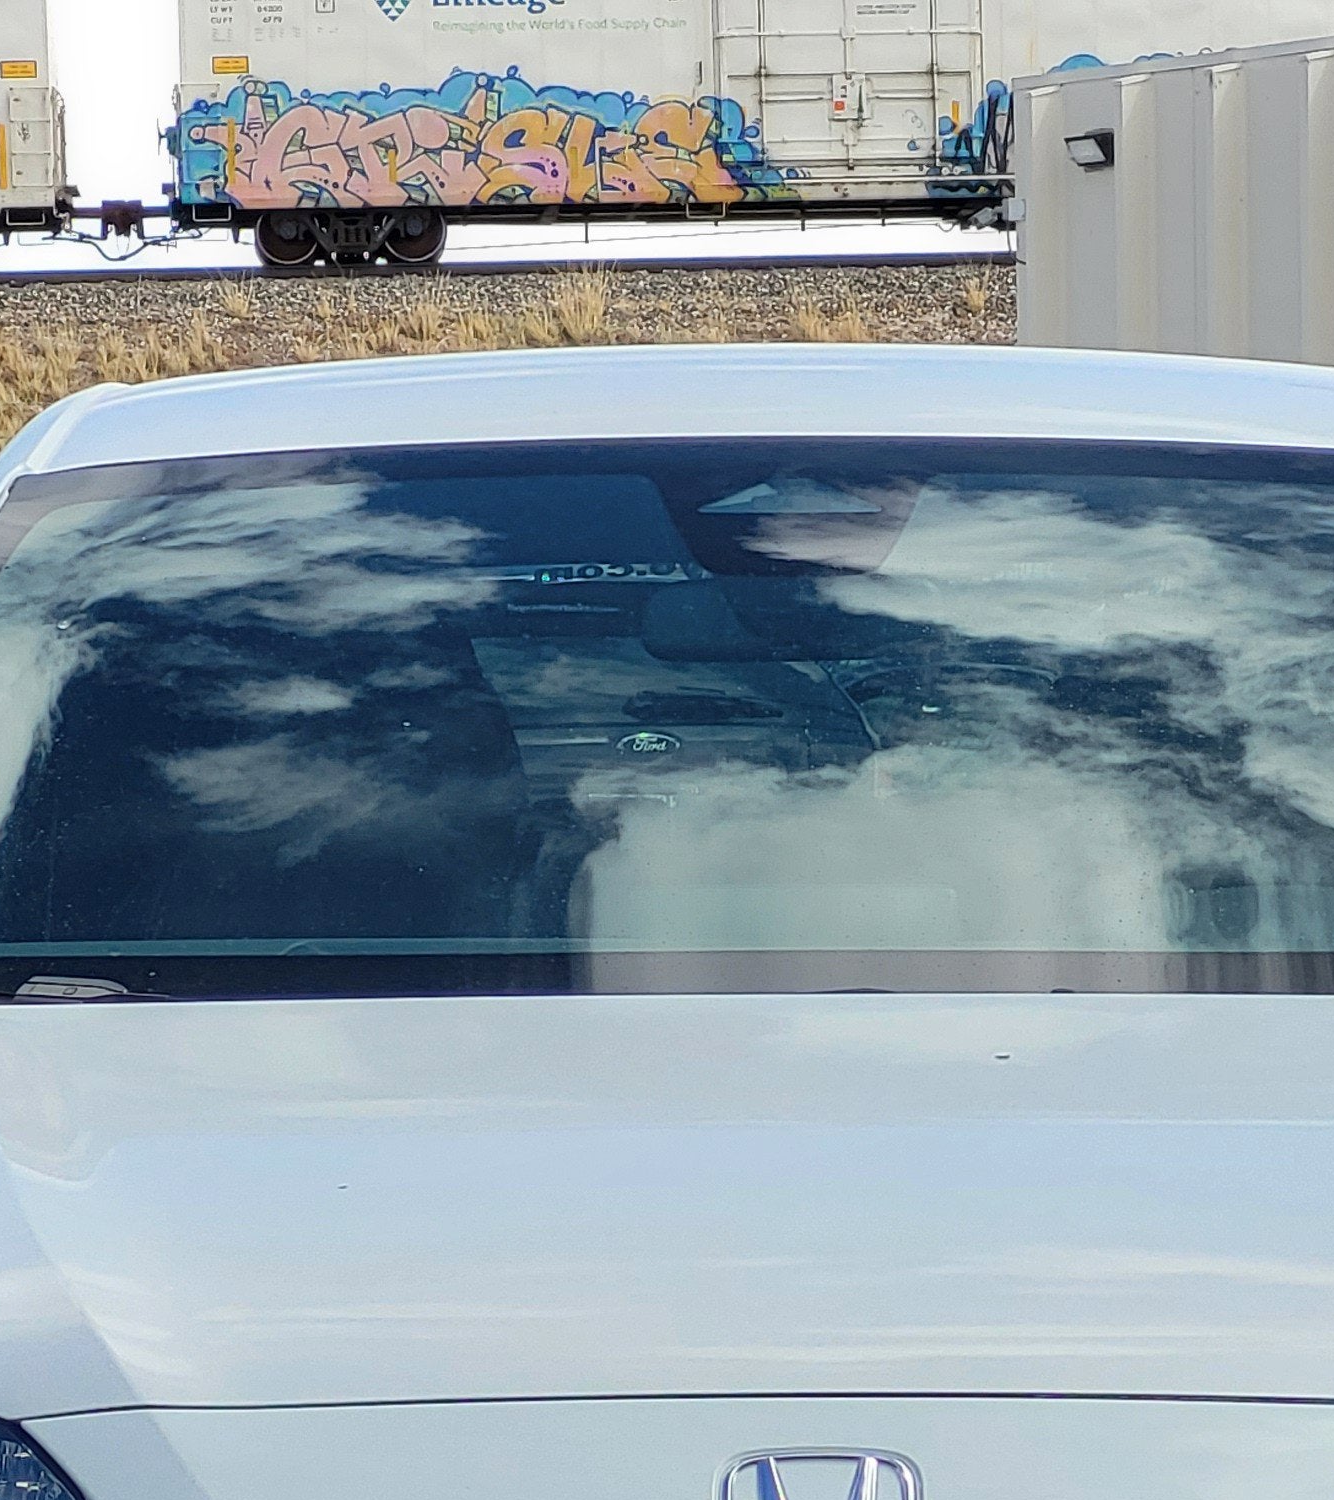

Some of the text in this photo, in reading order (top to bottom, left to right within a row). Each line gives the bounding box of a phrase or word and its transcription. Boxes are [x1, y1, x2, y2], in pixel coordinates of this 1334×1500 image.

[506, 20, 526, 31] the
[578, 18, 607, 30] Food
[610, 18, 649, 31] Supply
[652, 17, 687, 29] Chain
[632, 737, 668, 752] Ford
